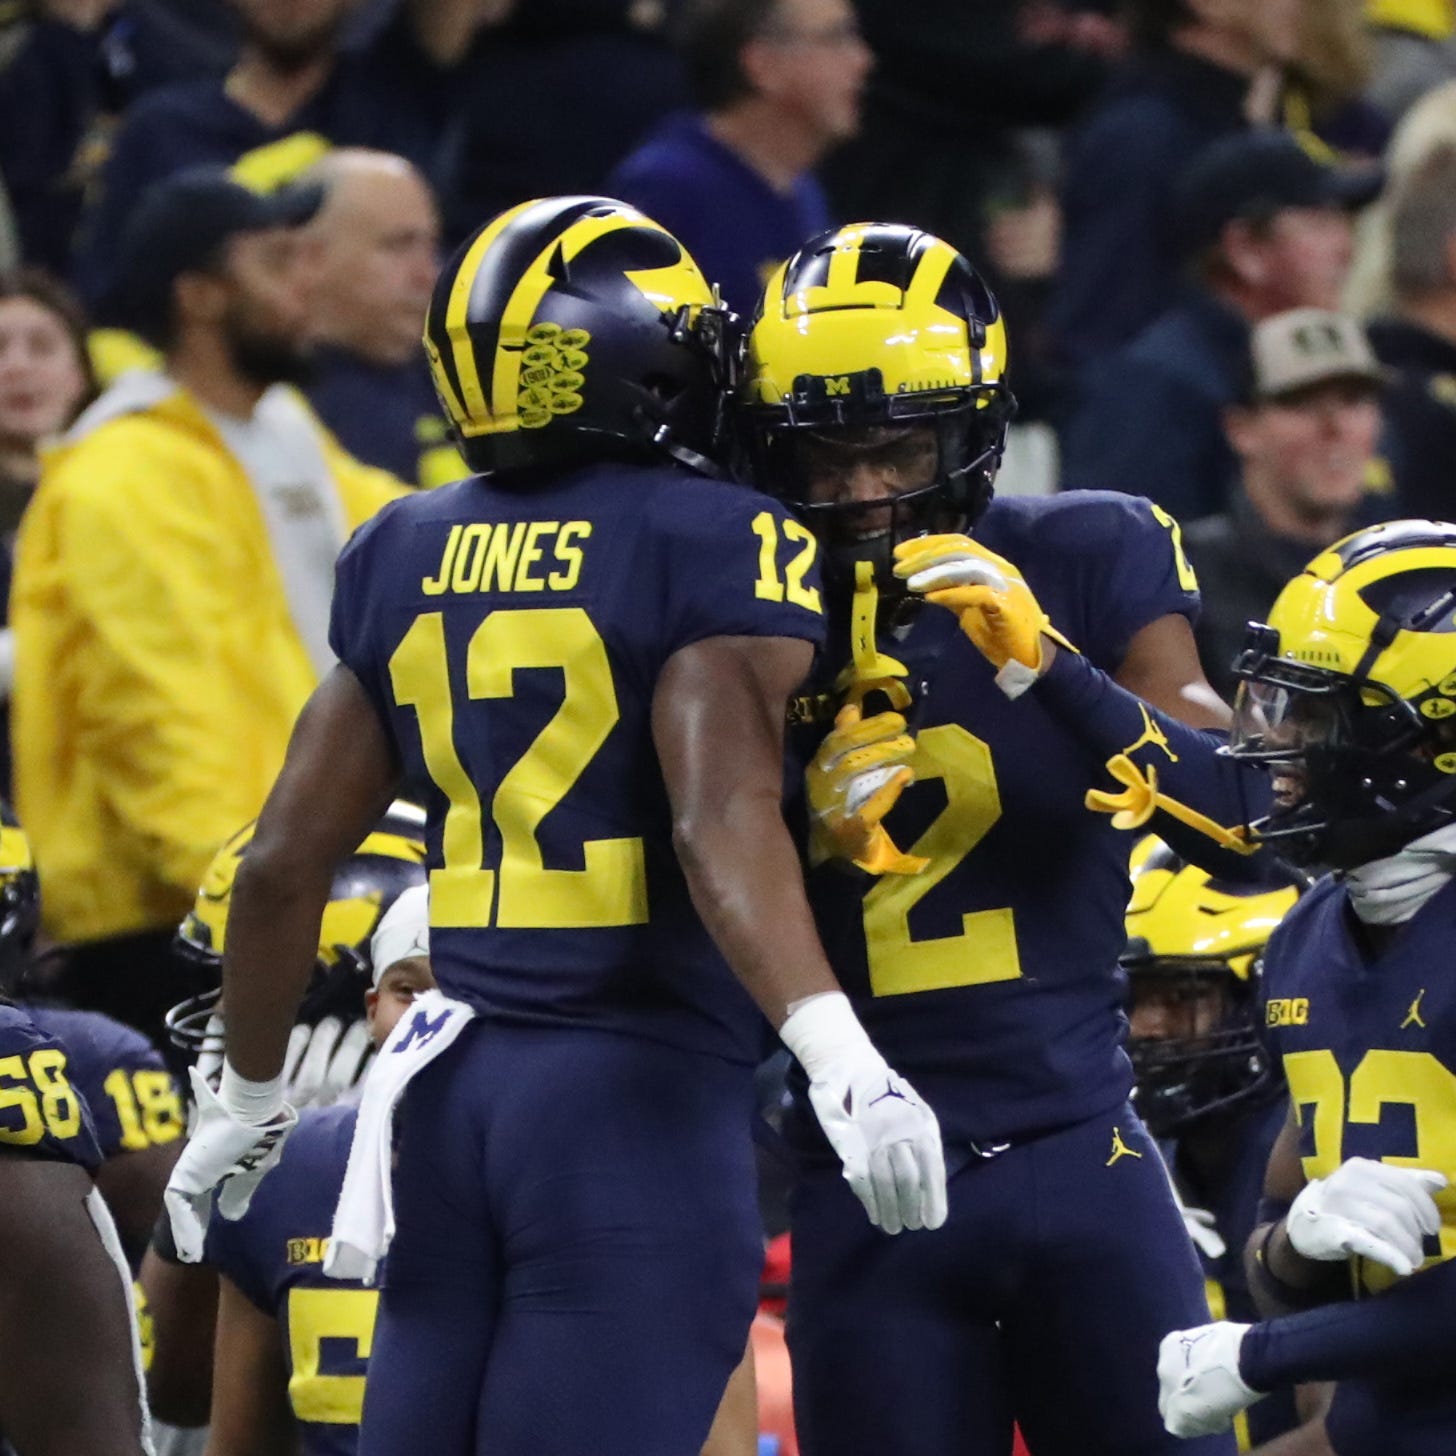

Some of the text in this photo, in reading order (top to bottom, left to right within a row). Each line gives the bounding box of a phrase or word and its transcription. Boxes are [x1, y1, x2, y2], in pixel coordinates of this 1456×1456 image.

[825, 377, 851, 396] M
[423, 522, 592, 595] JONES
[751, 511, 823, 614] 12
[389, 609, 650, 928] 12
[862, 722, 1023, 997] 2
[393, 1008, 453, 1053] M
[104, 1068, 183, 1150] 18
